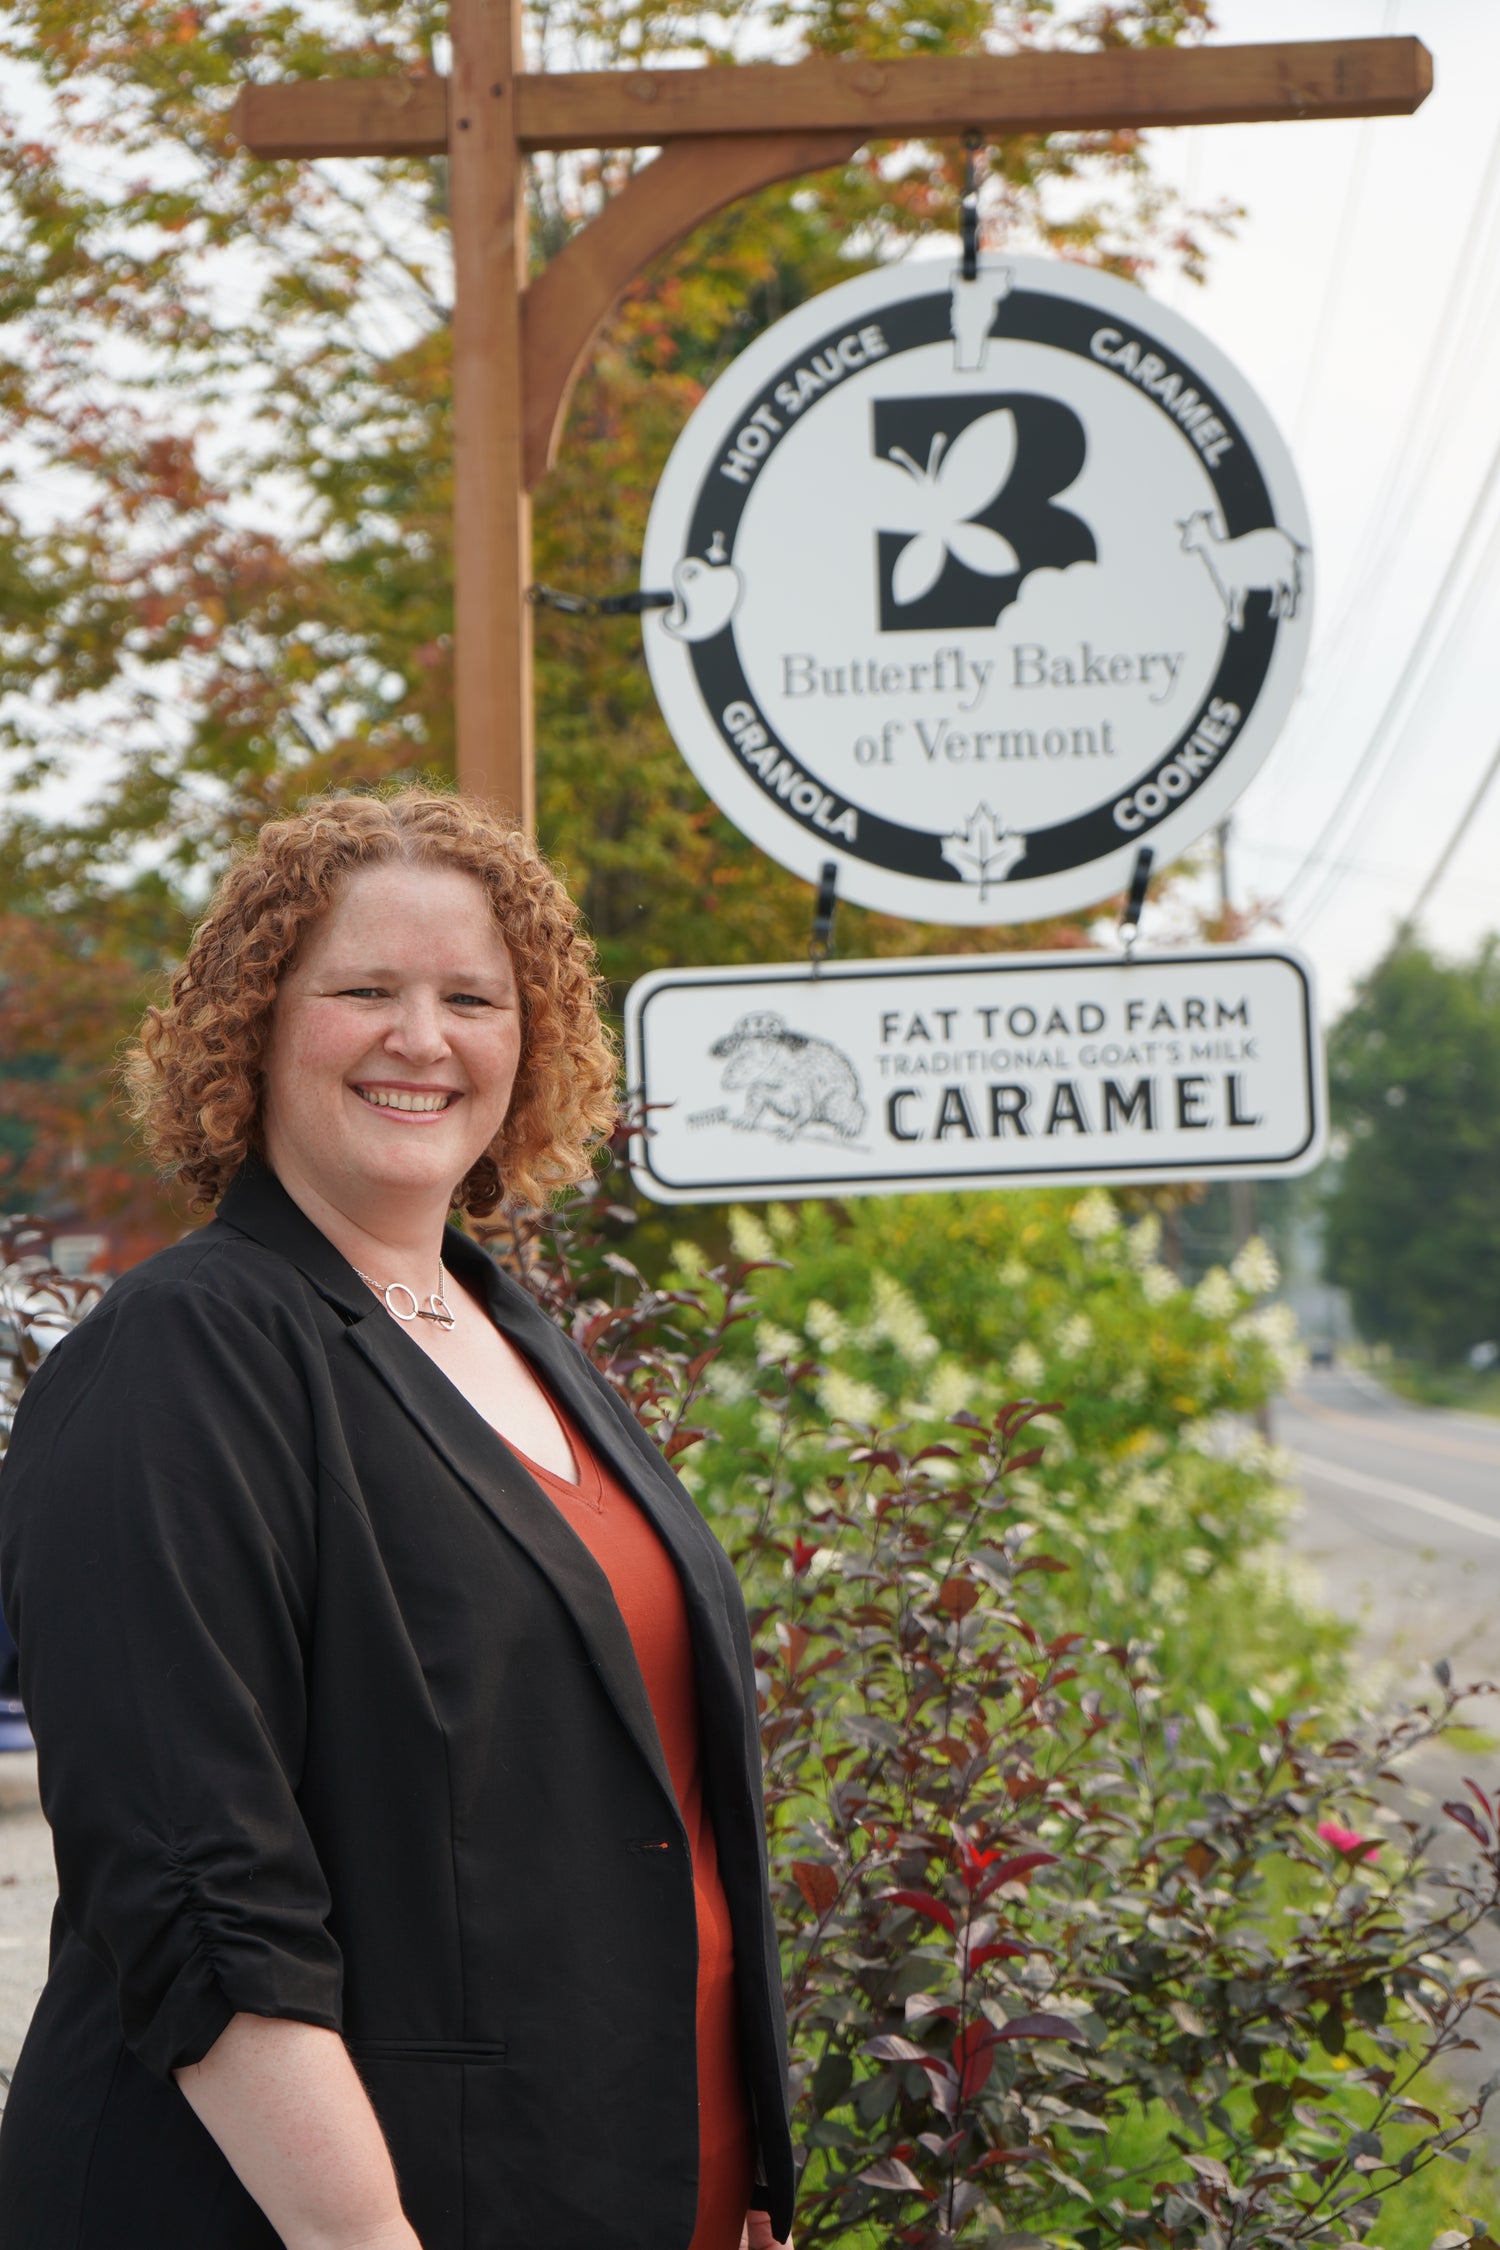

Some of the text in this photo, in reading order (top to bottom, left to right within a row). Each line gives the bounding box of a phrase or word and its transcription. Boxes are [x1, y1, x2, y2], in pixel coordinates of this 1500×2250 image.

[720, 325, 890, 484] HOT SAUCE
[1089, 327, 1236, 468] CARAMEL
[780, 642, 1186, 711] Butterfly Bakery
[722, 701, 858, 842] GRANOLA
[853, 718, 1114, 765] of Vermont
[1112, 697, 1240, 831] COOKIES
[881, 997, 1249, 1044] FAT TOAD FARM
[876, 1038, 1259, 1077] TRADITIONAL GOAT'S MILK
[886, 1071, 1262, 1142] CARAMEL
